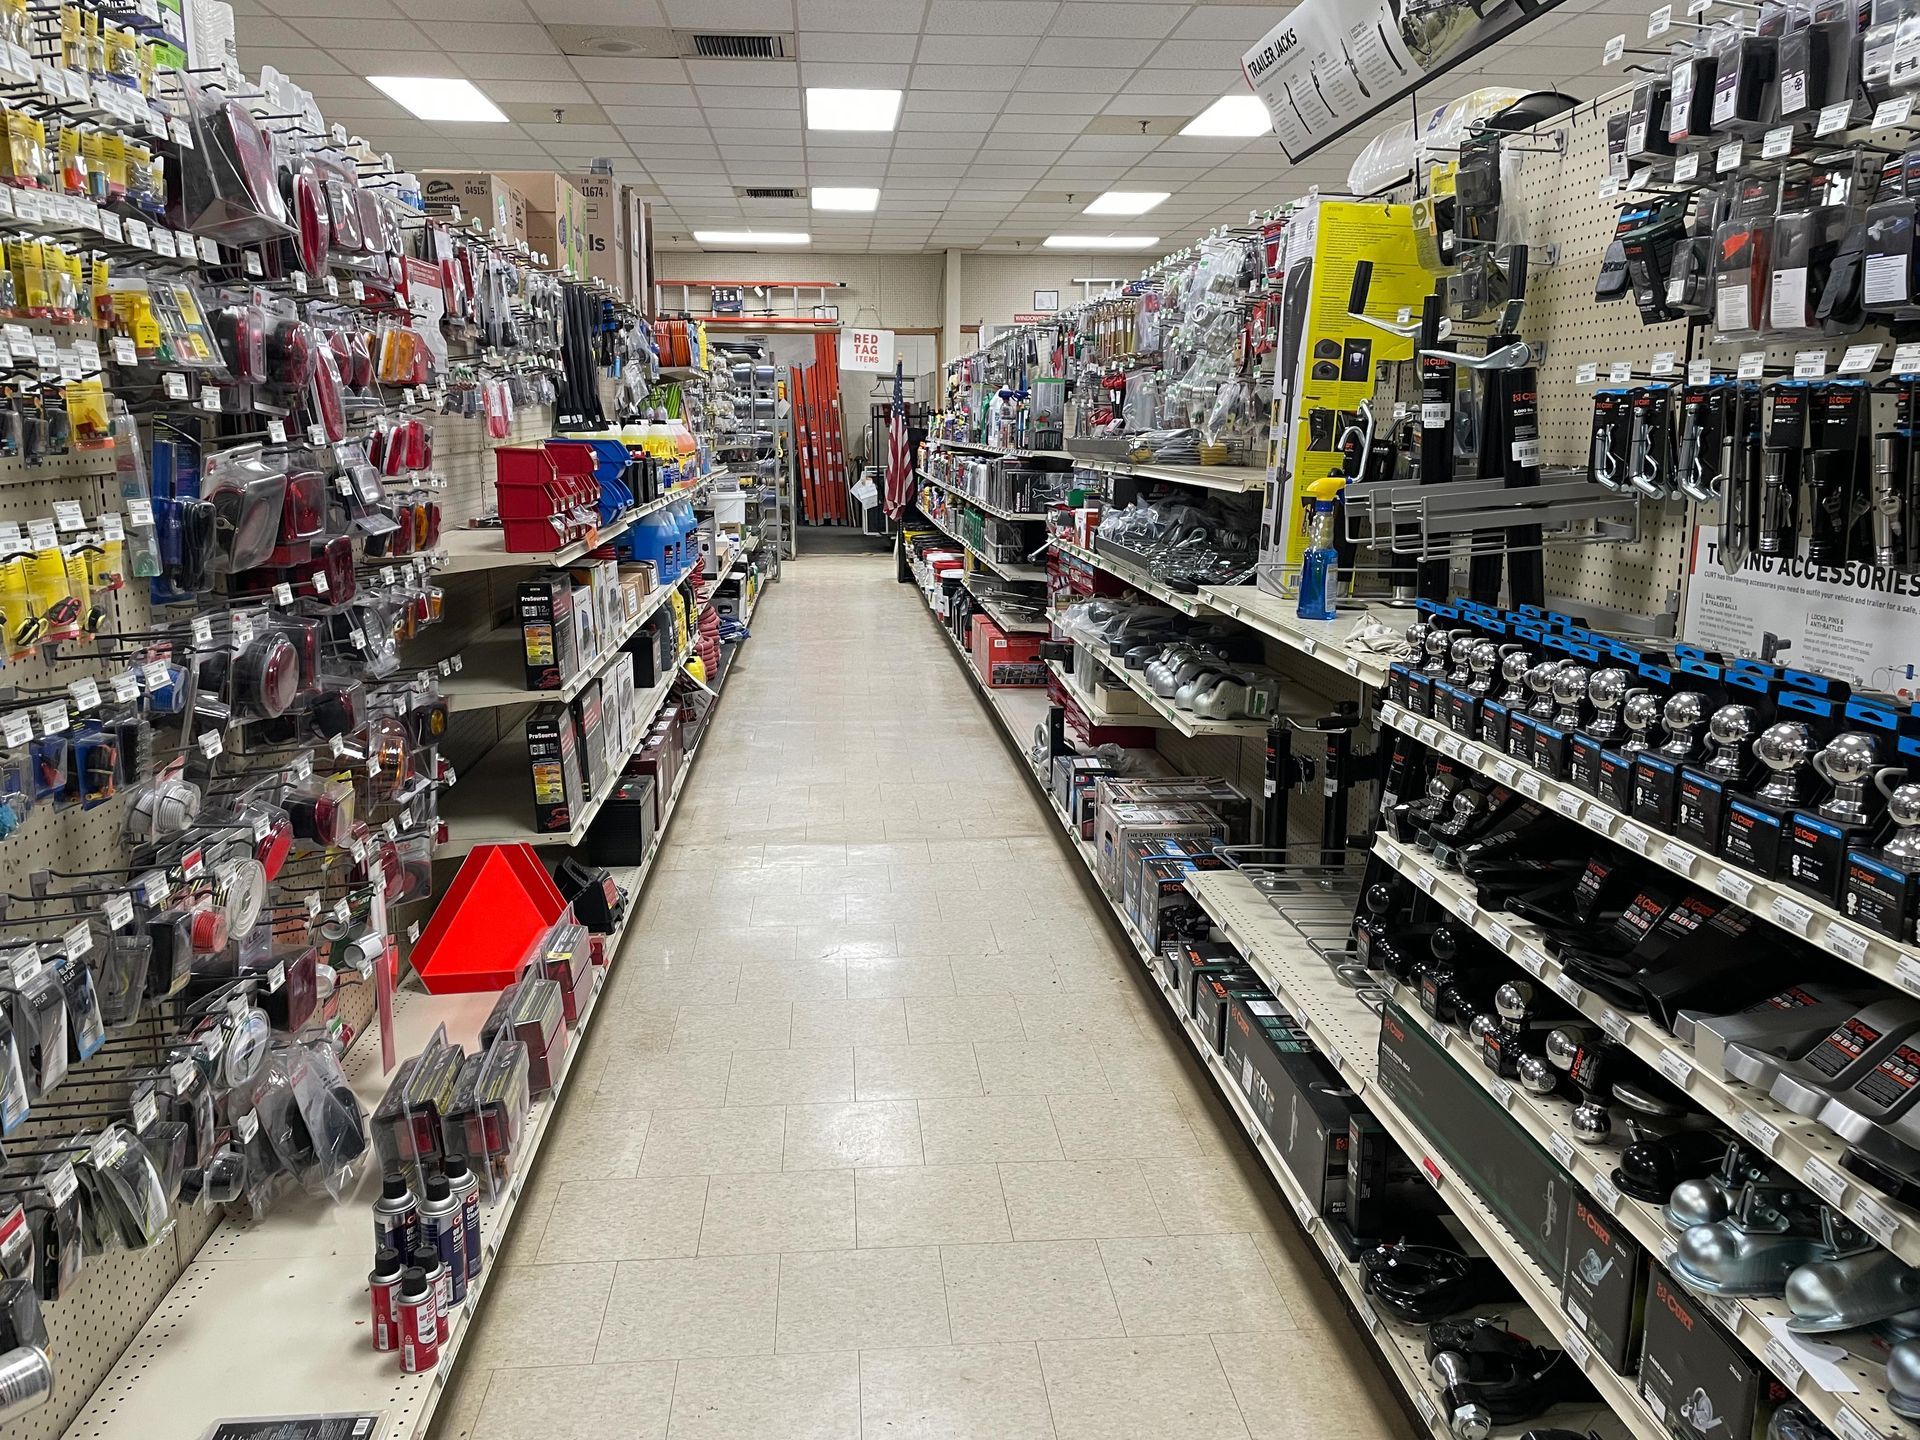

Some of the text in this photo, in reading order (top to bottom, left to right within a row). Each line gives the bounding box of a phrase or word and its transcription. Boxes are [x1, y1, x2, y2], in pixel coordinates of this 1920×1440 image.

[1247, 46, 1277, 79] TRAILER
[1273, 27, 1298, 58] JACKS
[465, 186, 485, 195] 04515
[854, 333, 879, 344] RED
[854, 344, 878, 355] TAG
[855, 355, 880, 364] ITEMS
[1707, 542, 1920, 597] TING ACCESSORIES
[1704, 570, 1717, 579] CURT
[1717, 573, 1726, 581] has
[1733, 575, 1749, 586] towing
[1749, 578, 1777, 590] accessories
[1777, 583, 1786, 592] you
[1786, 584, 1799, 594] need
[1806, 588, 1821, 597] outfit
[1821, 592, 1834, 600] your
[1834, 592, 1854, 604] vehicle
[1855, 597, 1866, 606] and
[1866, 599, 1886, 609] trailer
[1886, 602, 1896, 611] for
[1902, 605, 1918, 616] safe,
[1828, 616, 1839, 624] PINS
[1810, 621, 1844, 633] ANTI-RATTLES
[528, 732, 558, 740] ProSource
[1642, 898, 1663, 916] CURT
[1587, 1213, 1611, 1246] CURT
[1667, 1294, 1694, 1332] CURT
